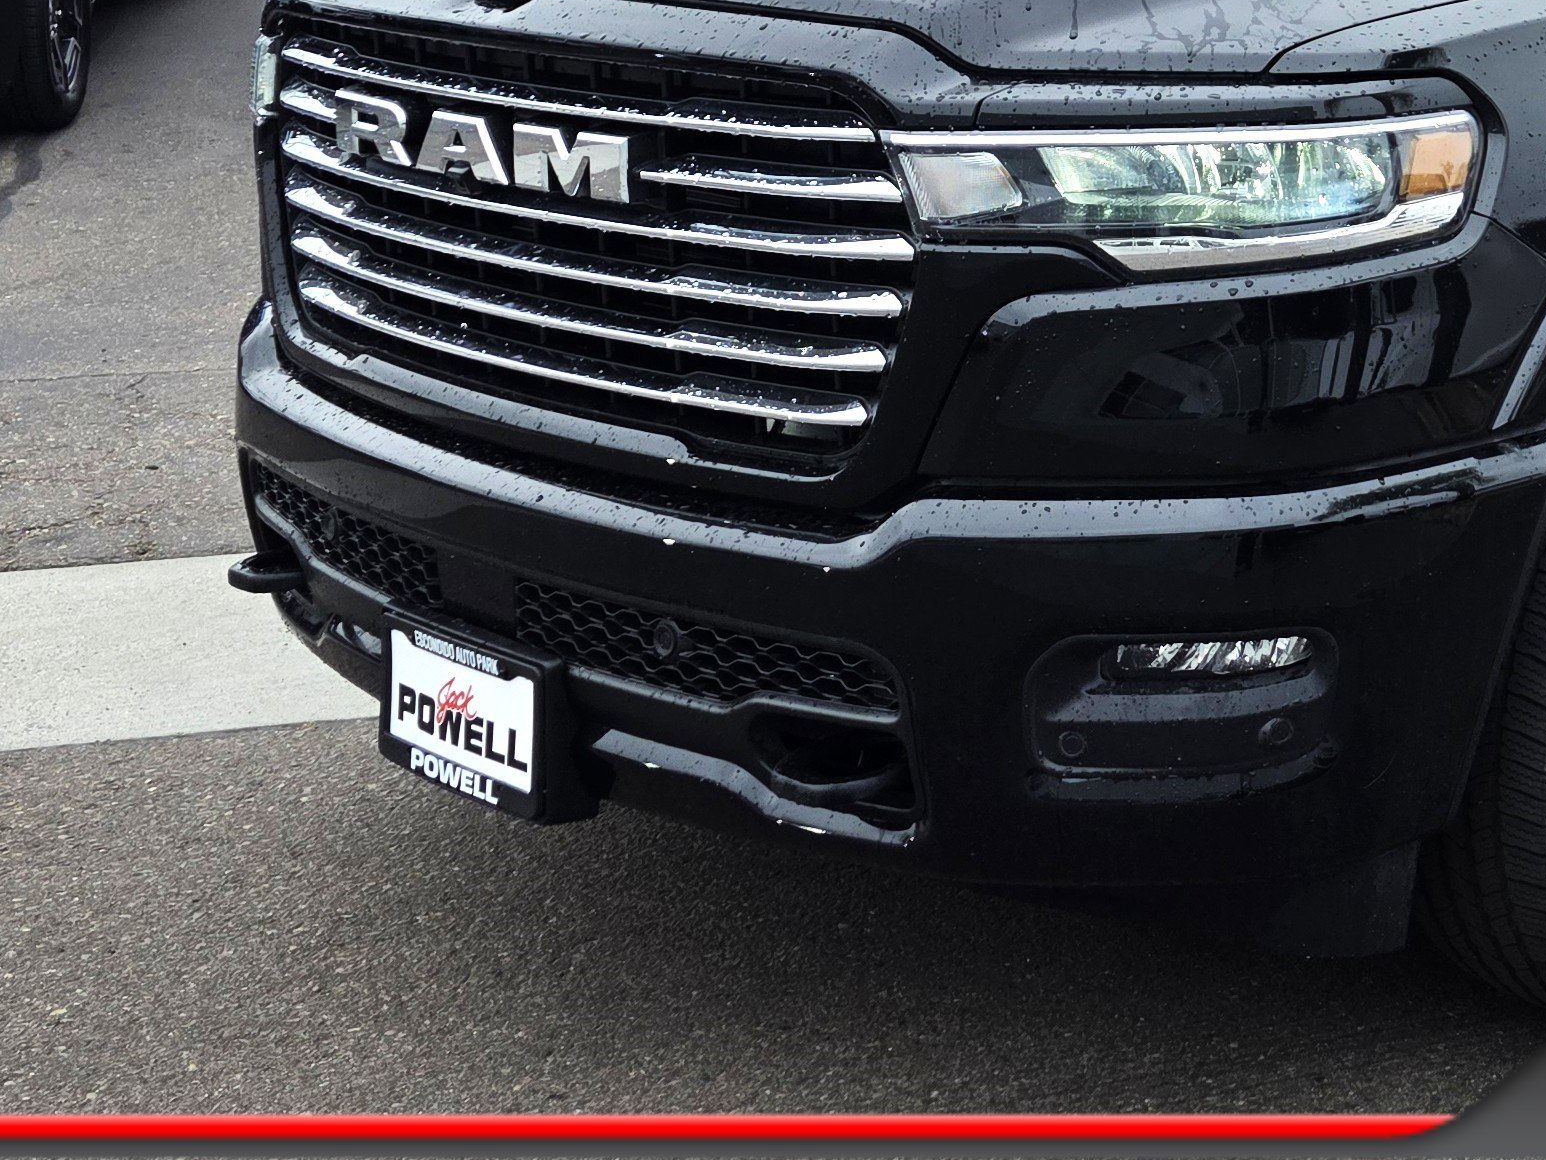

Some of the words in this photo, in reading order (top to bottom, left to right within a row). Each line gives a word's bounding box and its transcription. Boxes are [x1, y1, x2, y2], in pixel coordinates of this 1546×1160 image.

[334, 88, 631, 205] RAM
[413, 629, 455, 661] ESCONDIDO
[455, 645, 476, 668] AUTO
[476, 653, 500, 676] PARK
[397, 682, 528, 774] POWELL
[435, 676, 478, 725] Jack
[410, 746, 500, 806] POWELL
